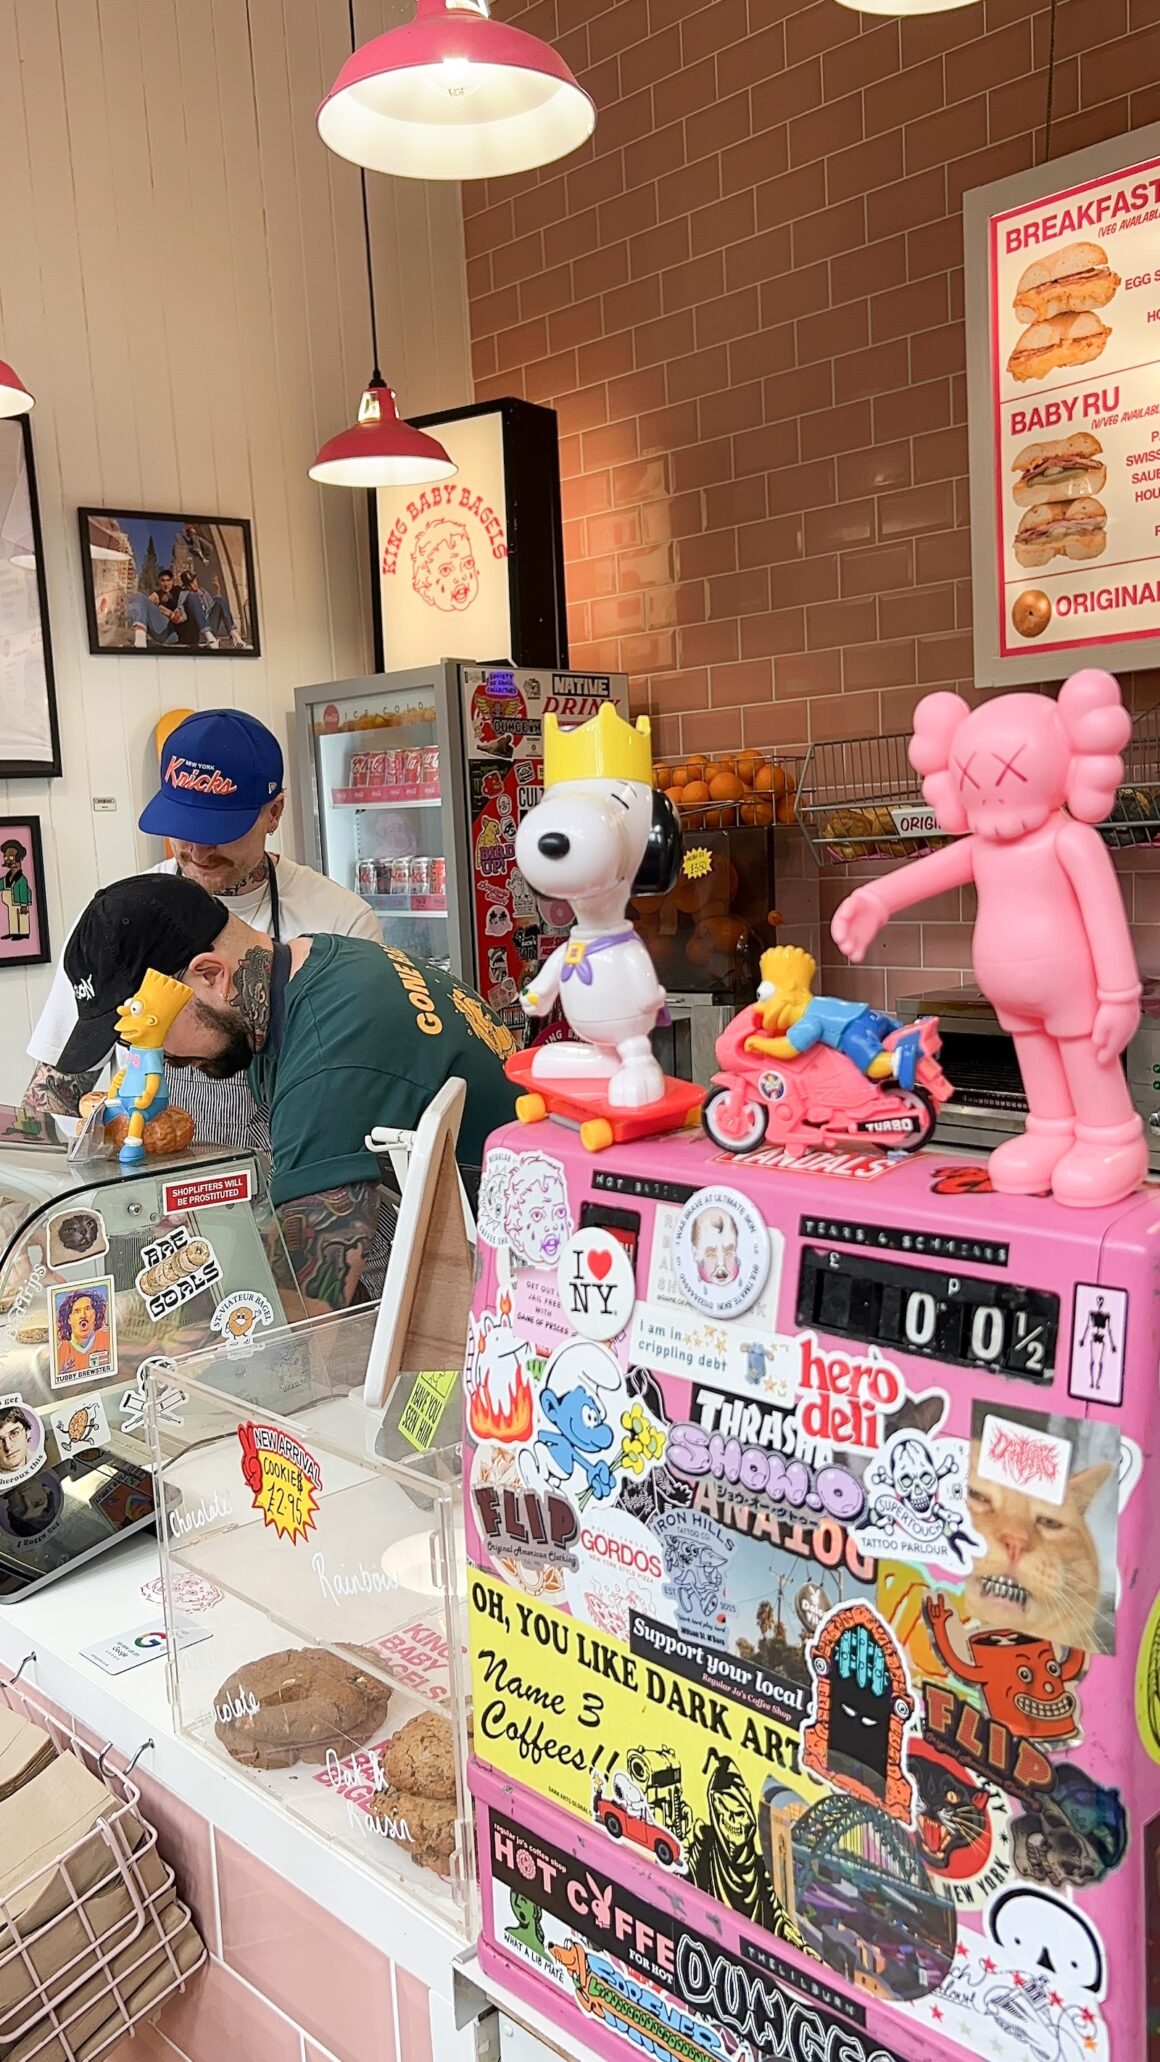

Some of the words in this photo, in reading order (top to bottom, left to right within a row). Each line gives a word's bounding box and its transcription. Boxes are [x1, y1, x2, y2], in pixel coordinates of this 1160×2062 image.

[1006, 178, 1160, 254] BREAKFAST
[1119, 208, 1160, 231] AVAILABL
[1125, 273, 1151, 290] EGG
[1011, 396, 1079, 436] BABY
[1082, 386, 1120, 418] RU
[1121, 403, 1160, 423] AVAILABL
[1135, 488, 1160, 502] HOU
[383, 517, 408, 575] KING
[406, 485, 457, 522] BABY
[459, 487, 508, 560] BAGELS
[553, 677, 609, 696] NATIVE
[164, 755, 237, 795] Knicks
[185, 760, 197, 768] NEW
[198, 763, 215, 771] YORK
[900, 816, 941, 831] ORIGI
[480, 844, 516, 860] BIRD
[544, 1030, 563, 1044] ING
[865, 1118, 913, 1133] TURBO
[172, 1181, 223, 1198] SHOPLIFTERS
[224, 1178, 243, 1189] WILL
[177, 1196, 188, 1206] BE
[189, 1188, 240, 1204] PROSTITUTED
[596, 1174, 623, 1189] HOT
[704, 1194, 713, 1203] AT
[714, 1194, 745, 1215] ULTIMATE
[805, 1221, 865, 1241] TEARS
[573, 1250, 584, 1279] I
[829, 1252, 841, 1269] £
[15, 1263, 47, 1308] Trips
[150, 1261, 219, 1317] GOALS
[526, 1281, 539, 1290] GET
[541, 1285, 555, 1295] OUT
[528, 1293, 542, 1303] JAIL
[544, 1298, 561, 1308] FREE
[569, 1282, 618, 1314] NY
[535, 1307, 552, 1317] WITH
[639, 1318, 644, 1332] I
[648, 1323, 666, 1337] am
[670, 1324, 683, 1341] in
[904, 1291, 936, 1345] 0
[78, 1365, 111, 1377] BREWSTER
[638, 1337, 693, 1366] crippling
[698, 1353, 727, 1371] debt
[798, 1338, 900, 1404] hero
[402, 1404, 420, 1435] SEEN
[415, 1418, 433, 1448] HIM
[425, 1394, 443, 1424] YOU
[801, 1394, 880, 1449] deli
[30, 1454, 43, 1470] this
[254, 1430, 278, 1450] NEW
[279, 1436, 322, 1490] ARRIVAL
[169, 1488, 232, 1538] Chocolate
[267, 1481, 303, 1525] £2.95
[474, 1487, 579, 1551] FLIP
[878, 1499, 944, 1538] SUPERTOUCH
[653, 1511, 687, 1535] IRON
[692, 1513, 735, 1552] HILLS
[677, 1526, 699, 1538] TATTOO
[861, 1537, 898, 1550] TATTOO
[901, 1541, 948, 1556] PARLOUR
[487, 1541, 513, 1554] Original
[513, 1546, 547, 1559] American
[548, 1551, 577, 1567] Clothing
[581, 1529, 662, 1578] GORDOS
[312, 1552, 399, 1606] Rainbow
[378, 1634, 449, 1672] BABY
[633, 1617, 704, 1665] Support
[706, 1654, 753, 1686] your
[755, 1670, 804, 1711] local
[472, 1582, 511, 1632] OH,
[516, 1602, 569, 1655] YOU
[576, 1632, 639, 1692] LIKE
[646, 1666, 733, 1741] DARK
[741, 1717, 802, 1776] ART
[478, 1649, 566, 1716] Name
[577, 1692, 605, 1728] 3
[702, 1672, 732, 1692] Regular
[731, 1686, 747, 1700] Jo's
[747, 1693, 771, 1711] Coffee
[771, 1704, 792, 1721] Shop
[481, 1700, 620, 1782] Coffees!!
[926, 1685, 1051, 1786] FLIP
[346, 1800, 416, 1843] Raisin
[493, 1823, 515, 1840] regular
[516, 1836, 528, 1848] jo's
[528, 1845, 549, 1861] coffee
[550, 1858, 567, 1873] shop
[978, 1857, 1010, 1897] YORK
[504, 1932, 522, 1951] WHAT
[523, 1948, 530, 1958] A
[544, 1961, 564, 1983] MATE
[628, 1948, 650, 1971] FOR
[651, 1963, 674, 1985] HOT
